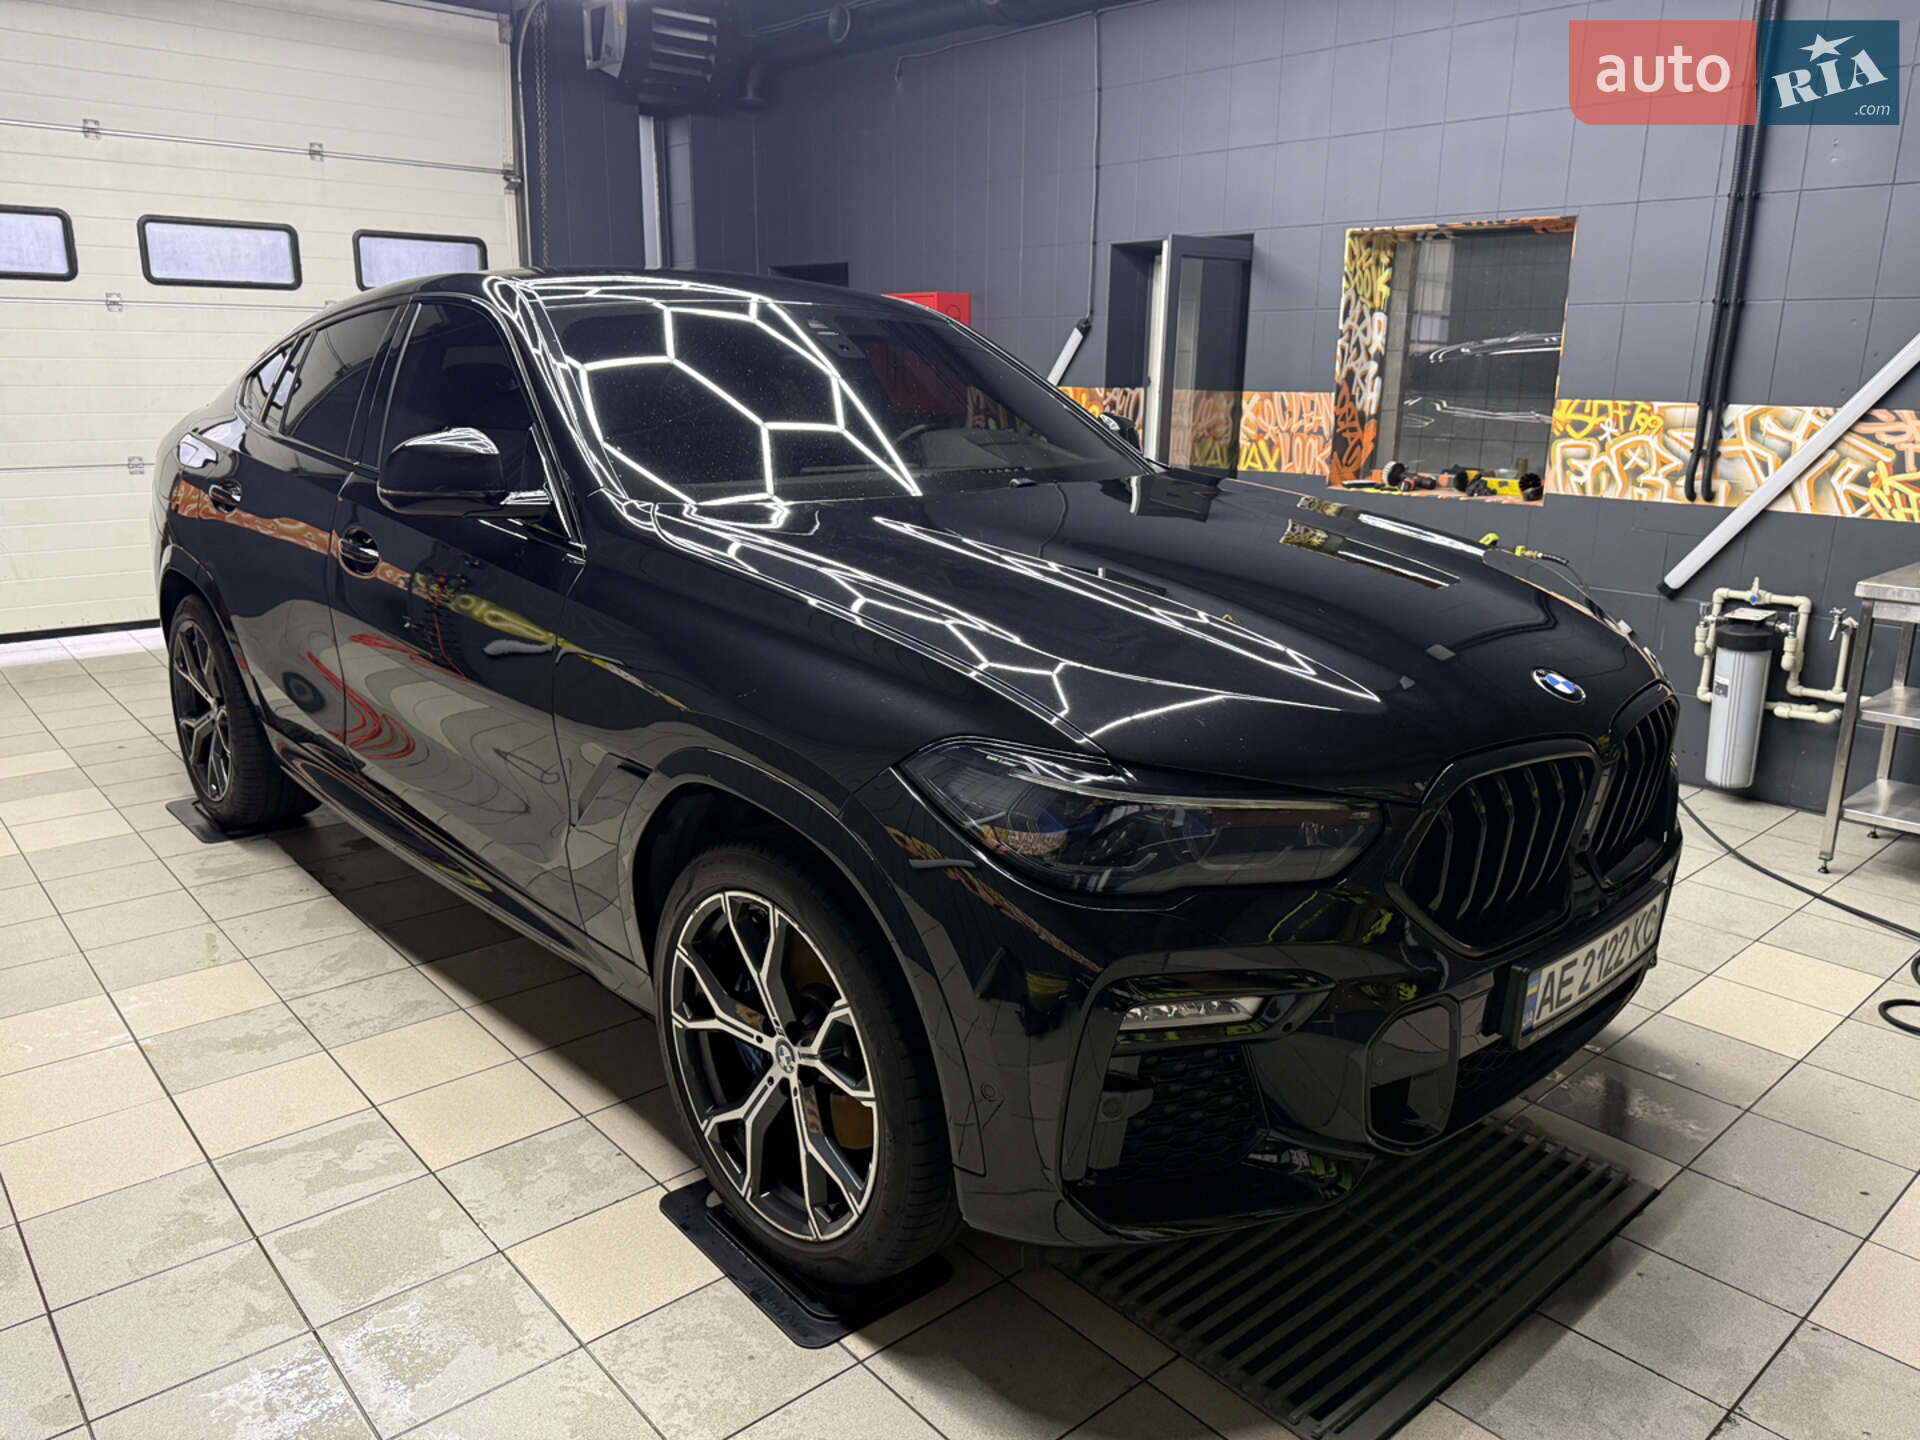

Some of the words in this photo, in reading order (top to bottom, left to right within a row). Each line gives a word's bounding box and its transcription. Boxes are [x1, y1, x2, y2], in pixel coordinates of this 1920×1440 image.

[1536, 957, 1578, 1021] AE
[1578, 925, 1630, 996] 2122
[1628, 903, 1658, 960] KC
